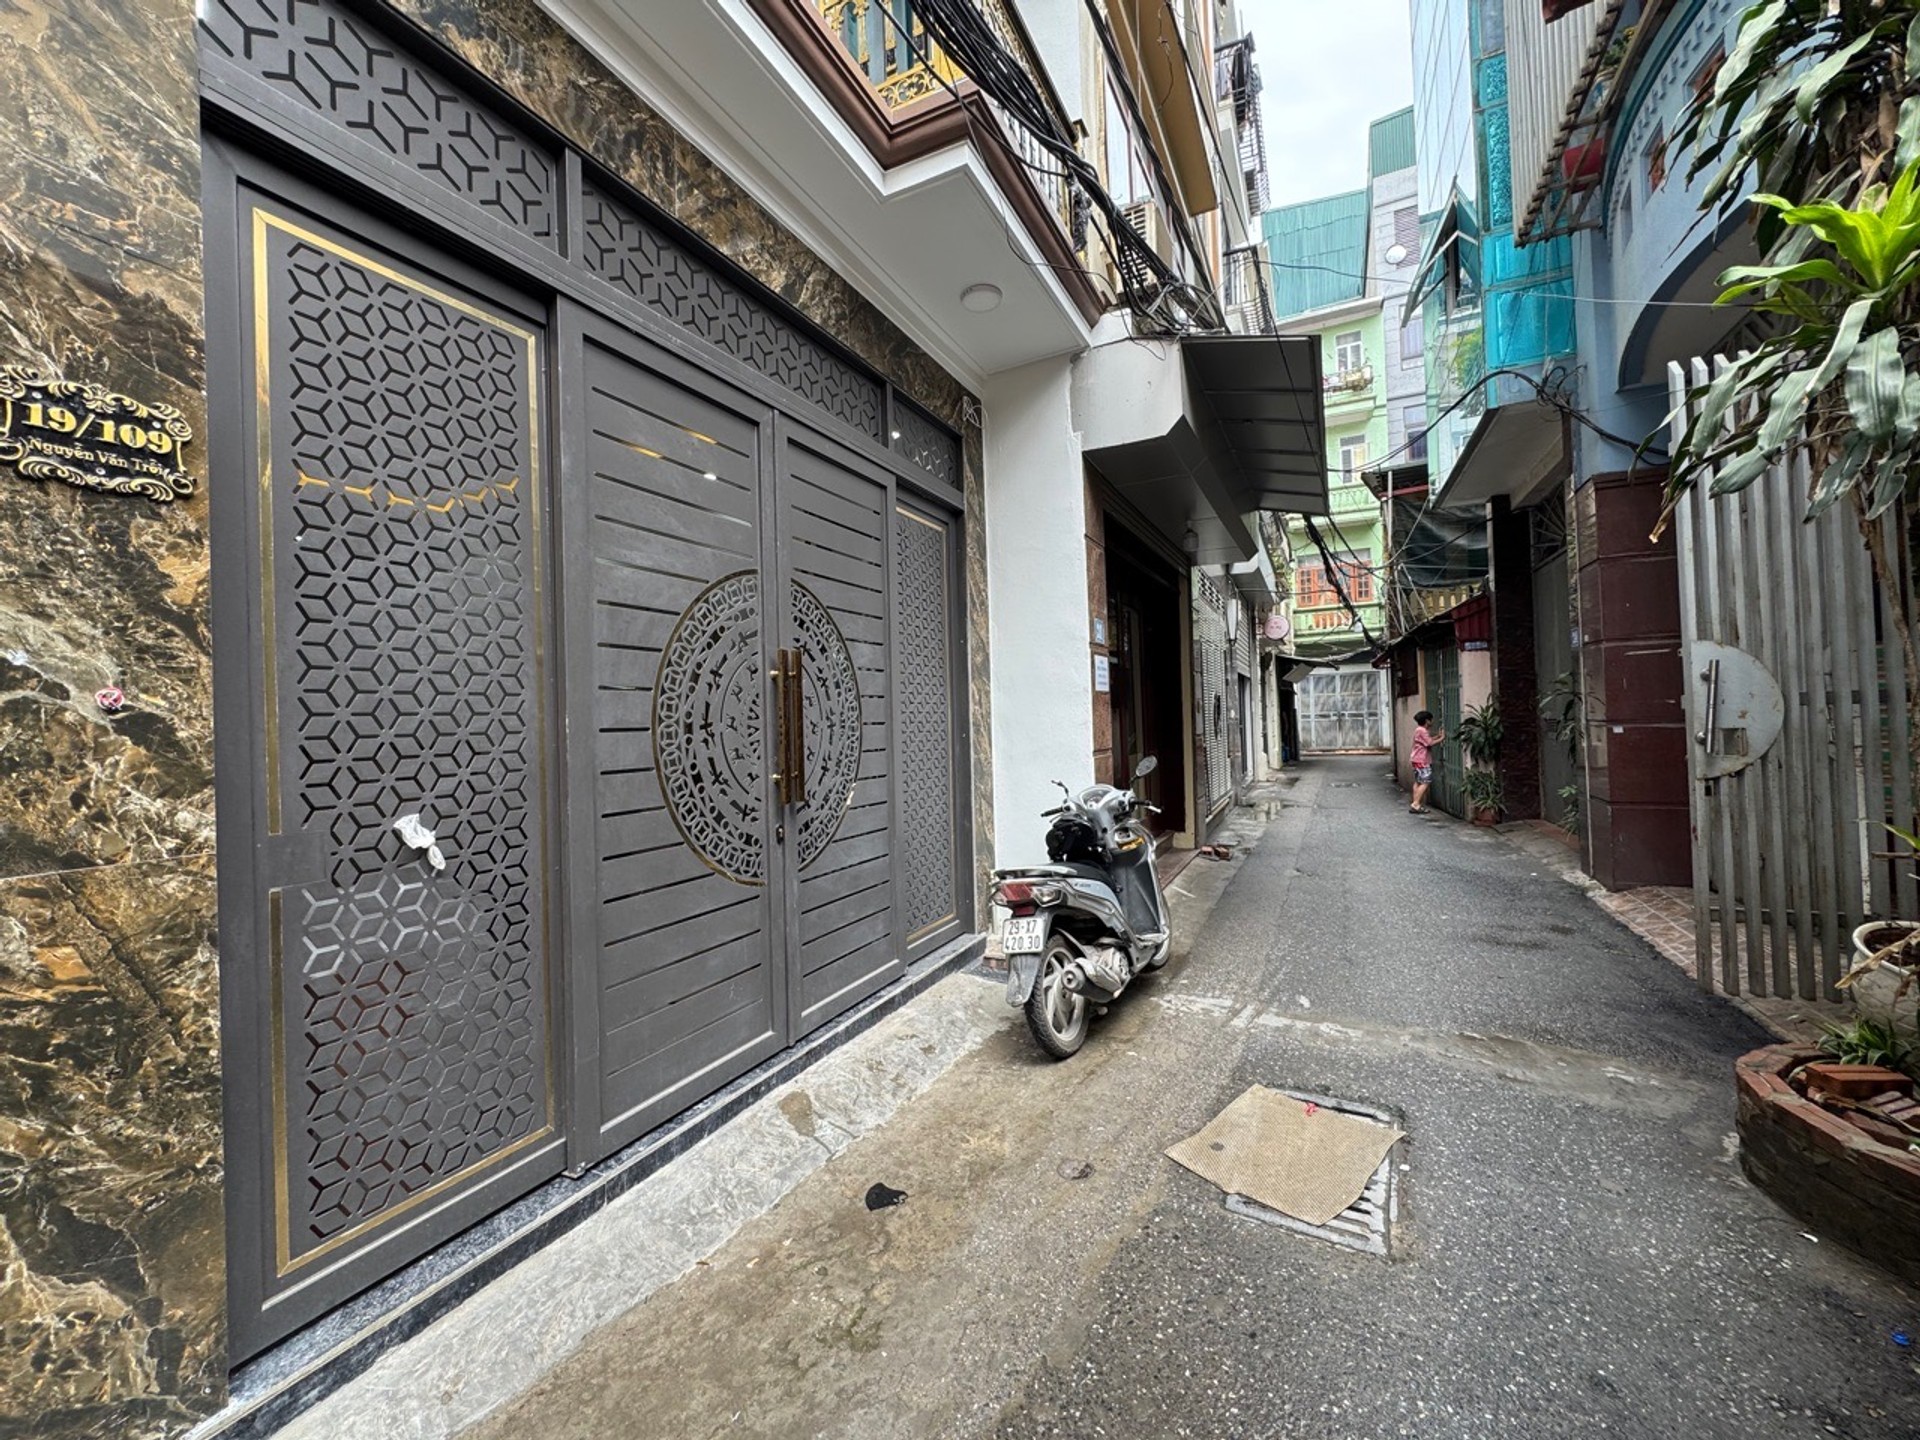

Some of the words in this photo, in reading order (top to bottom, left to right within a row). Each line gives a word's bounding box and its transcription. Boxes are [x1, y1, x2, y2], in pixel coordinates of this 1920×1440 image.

[21, 402, 173, 454] 19/109
[28, 436, 95, 461] Nguyễn
[95, 450, 128, 468] Văn
